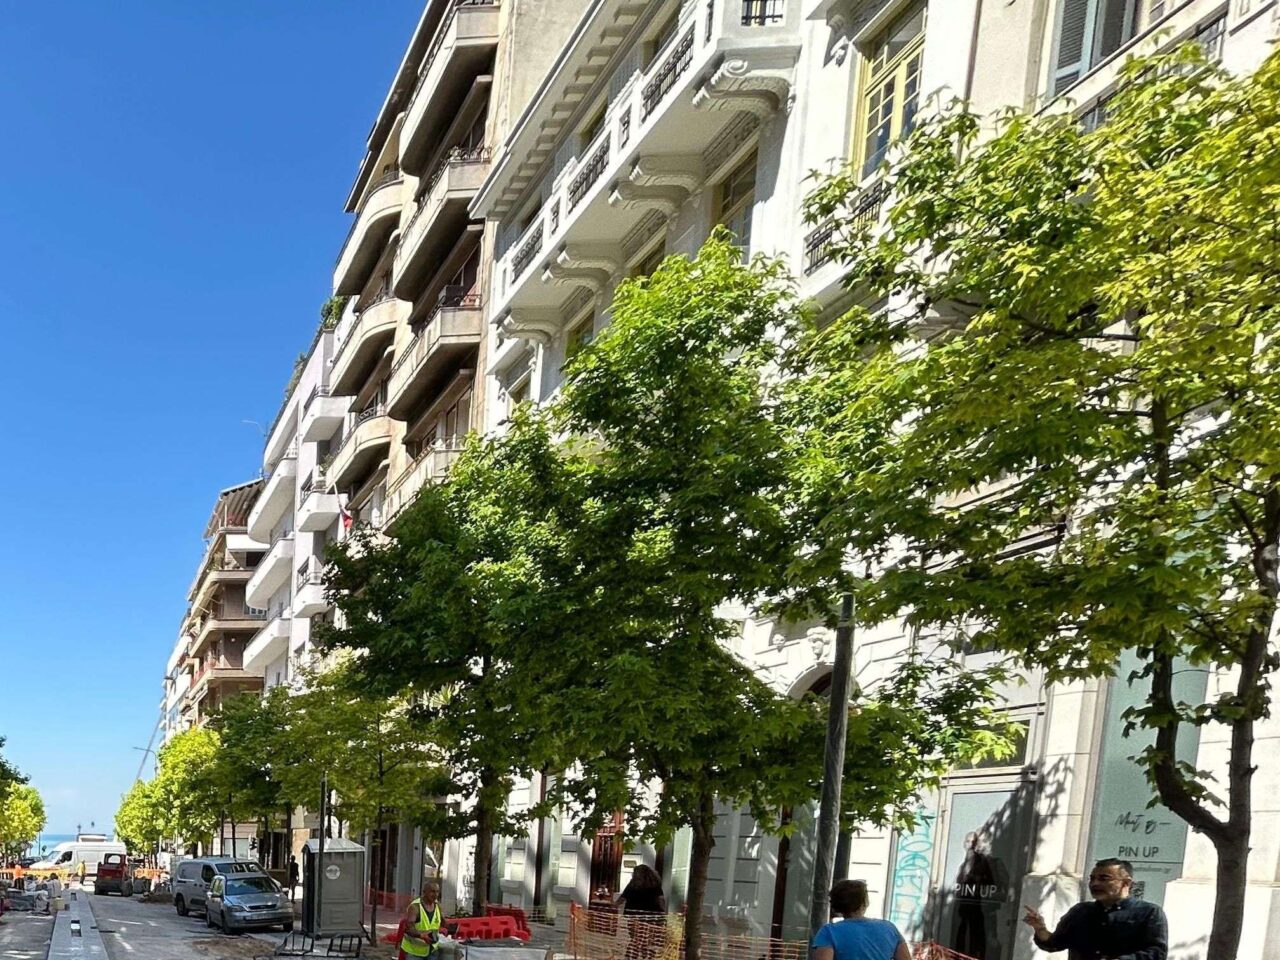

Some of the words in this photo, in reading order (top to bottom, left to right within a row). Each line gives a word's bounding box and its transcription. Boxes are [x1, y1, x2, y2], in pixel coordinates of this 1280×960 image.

[1118, 846, 1139, 857] PIN
[1142, 846, 1159, 858] UP
[955, 883, 976, 897] PIN
[980, 884, 997, 898] UP
